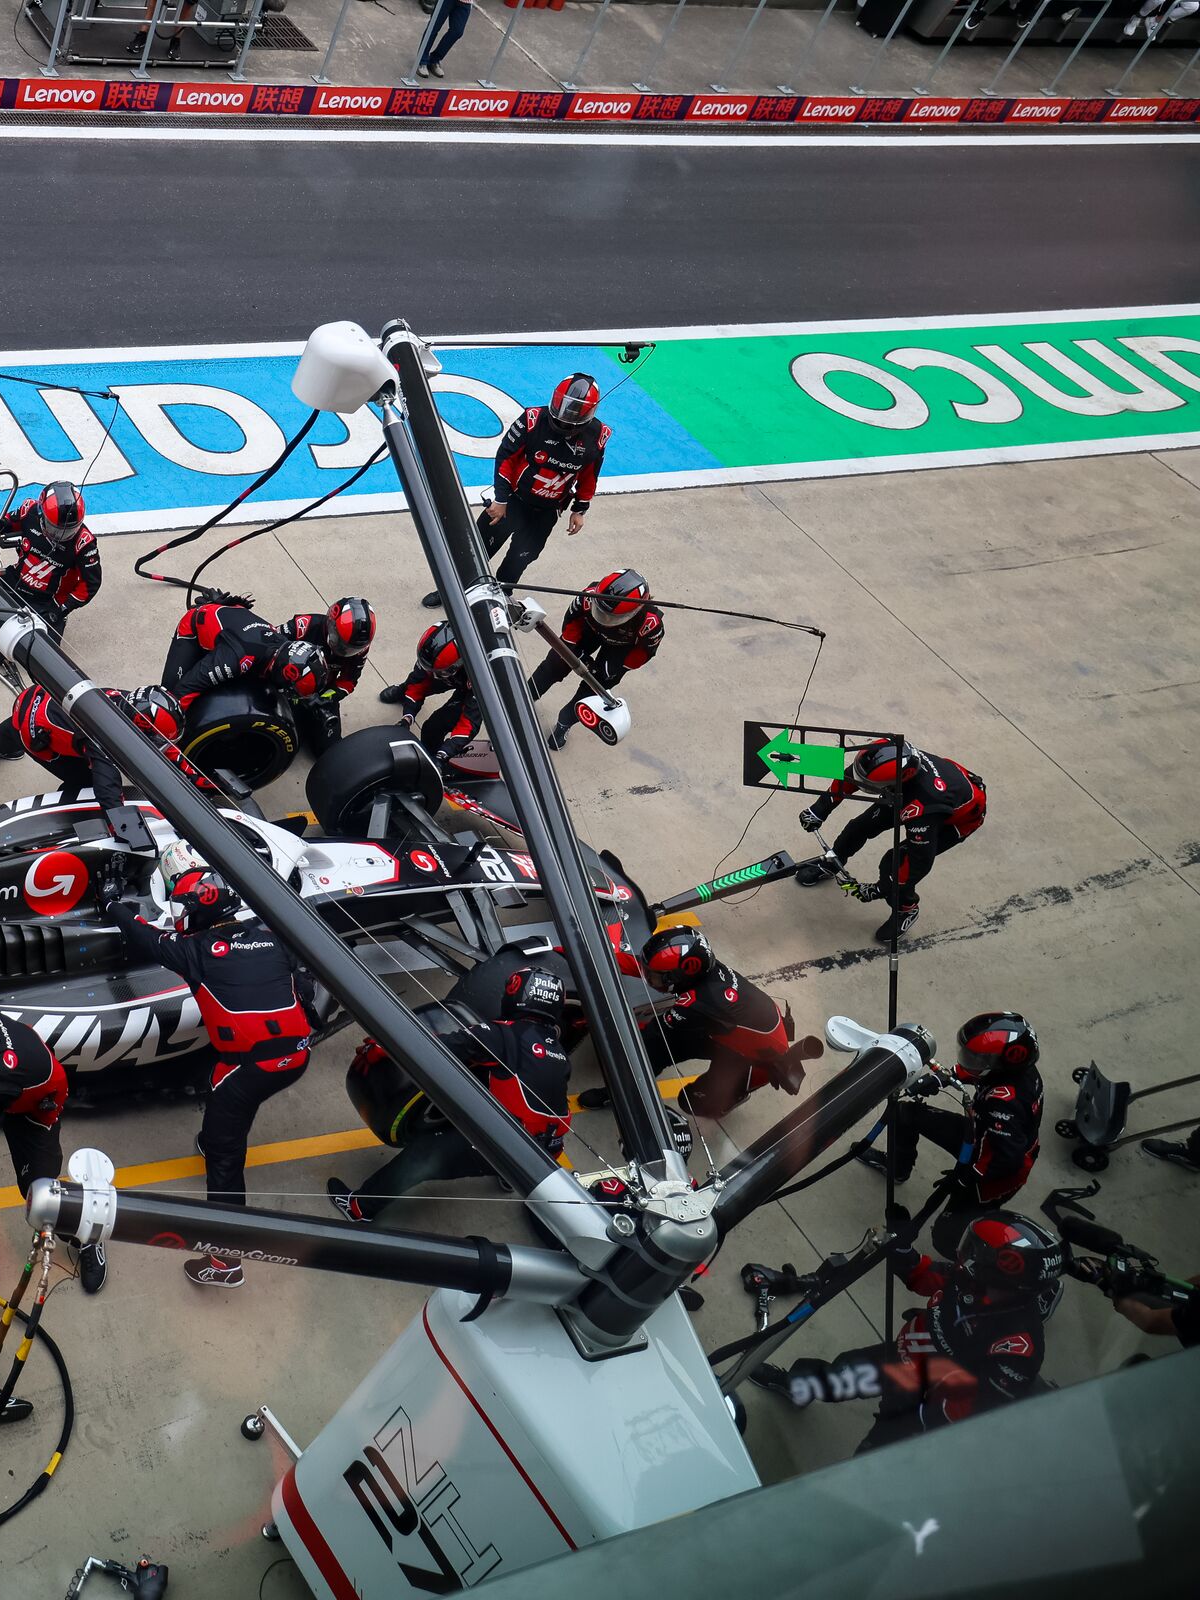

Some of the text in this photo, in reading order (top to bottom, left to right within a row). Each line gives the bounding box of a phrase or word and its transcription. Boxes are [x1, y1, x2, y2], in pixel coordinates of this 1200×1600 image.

[23, 85, 96, 104] Lenovo
[105, 82, 160, 108] 联想
[176, 88, 244, 107] Lenovo
[251, 86, 304, 112] 联想
[317, 93, 383, 109] Lenovo
[389, 91, 437, 115] 联想
[448, 96, 509, 112] Lenovo
[514, 93, 560, 118] 联想
[573, 98, 632, 114] Lenovo
[639, 96, 682, 119] 联想
[692, 101, 748, 116] Lenovo
[752, 98, 795, 120] 联想
[802, 102, 855, 117] Lenovo
[859, 99, 902, 121] 联想
[910, 103, 961, 117] Lenovo
[1011, 103, 1061, 118] Lenovo
[1110, 103, 1159, 117] Lenovo
[269, 723, 294, 752] ZERO
[230, 941, 274, 951] MoneyGram
[529, 986, 560, 1001] Angels
[534, 978, 560, 991] Palm
[193, 1241, 298, 1265] MoneyGram
[343, 1446, 463, 1596] 27
